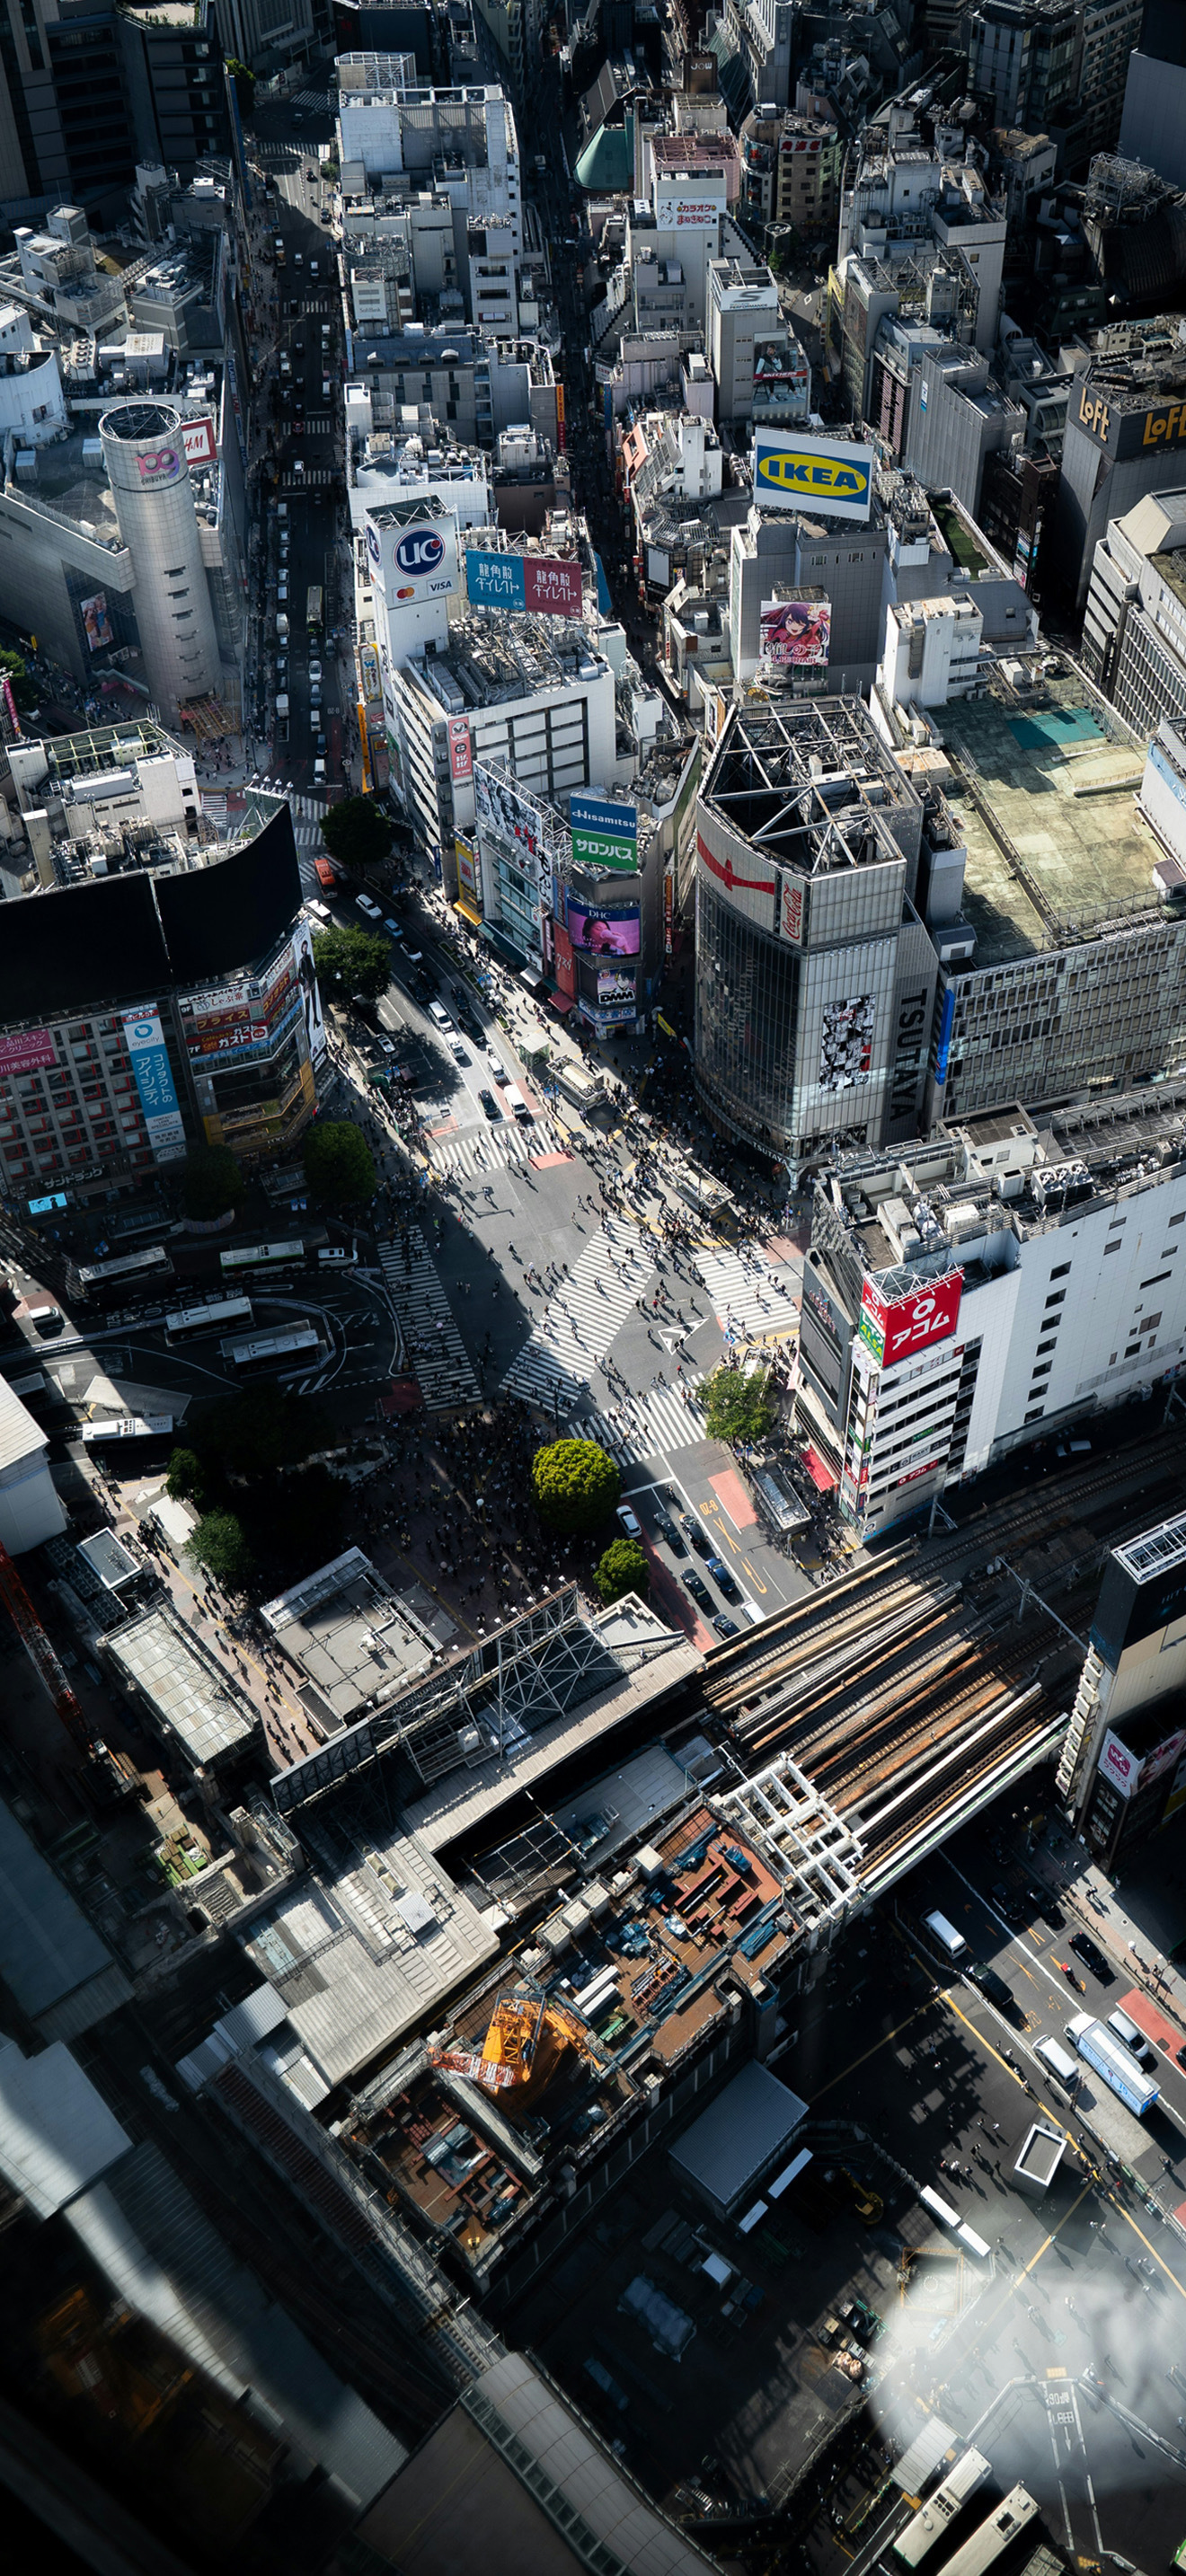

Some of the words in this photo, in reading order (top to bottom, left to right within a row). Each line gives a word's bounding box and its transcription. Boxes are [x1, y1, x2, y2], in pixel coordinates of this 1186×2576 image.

[682, 204, 712, 212] カラオケ
[677, 215, 712, 225] まねきねこ
[184, 435, 203, 452] H&M
[135, 449, 180, 479] 109
[141, 473, 167, 486] SHIBUYA
[768, 460, 859, 490] IKEA
[479, 563, 513, 579] 龍角散
[536, 569, 571, 587] 龍角散
[430, 580, 452, 592] VISA
[571, 809, 635, 828] Hisamitsu
[576, 838, 633, 861] サロンパス
[589, 909, 611, 920] DHC
[782, 881, 802, 940] Coca-Cola
[600, 991, 633, 1003] DMM
[6, 1033, 46, 1048] 品川スキン
[8, 1040, 43, 1054] クリニック
[132, 1036, 160, 1047] eyecity
[189, 1045, 201, 1054] 7F
[218, 1035, 249, 1049] ガスト
[890, 988, 927, 1122] TSUTAYA
[137, 1056, 158, 1106] アイシティ
[153, 1054, 173, 1103] コンタクトの
[752, 1141, 786, 1164] TSUTAYA
[43, 1166, 104, 1190] サンドラッグ
[864, 1293, 884, 1327] アコム
[862, 1311, 884, 1345] レイク
[892, 1310, 951, 1351] アコム
[861, 1324, 882, 1358] ALSA
[699, 1499, 719, 1516] 8-20
